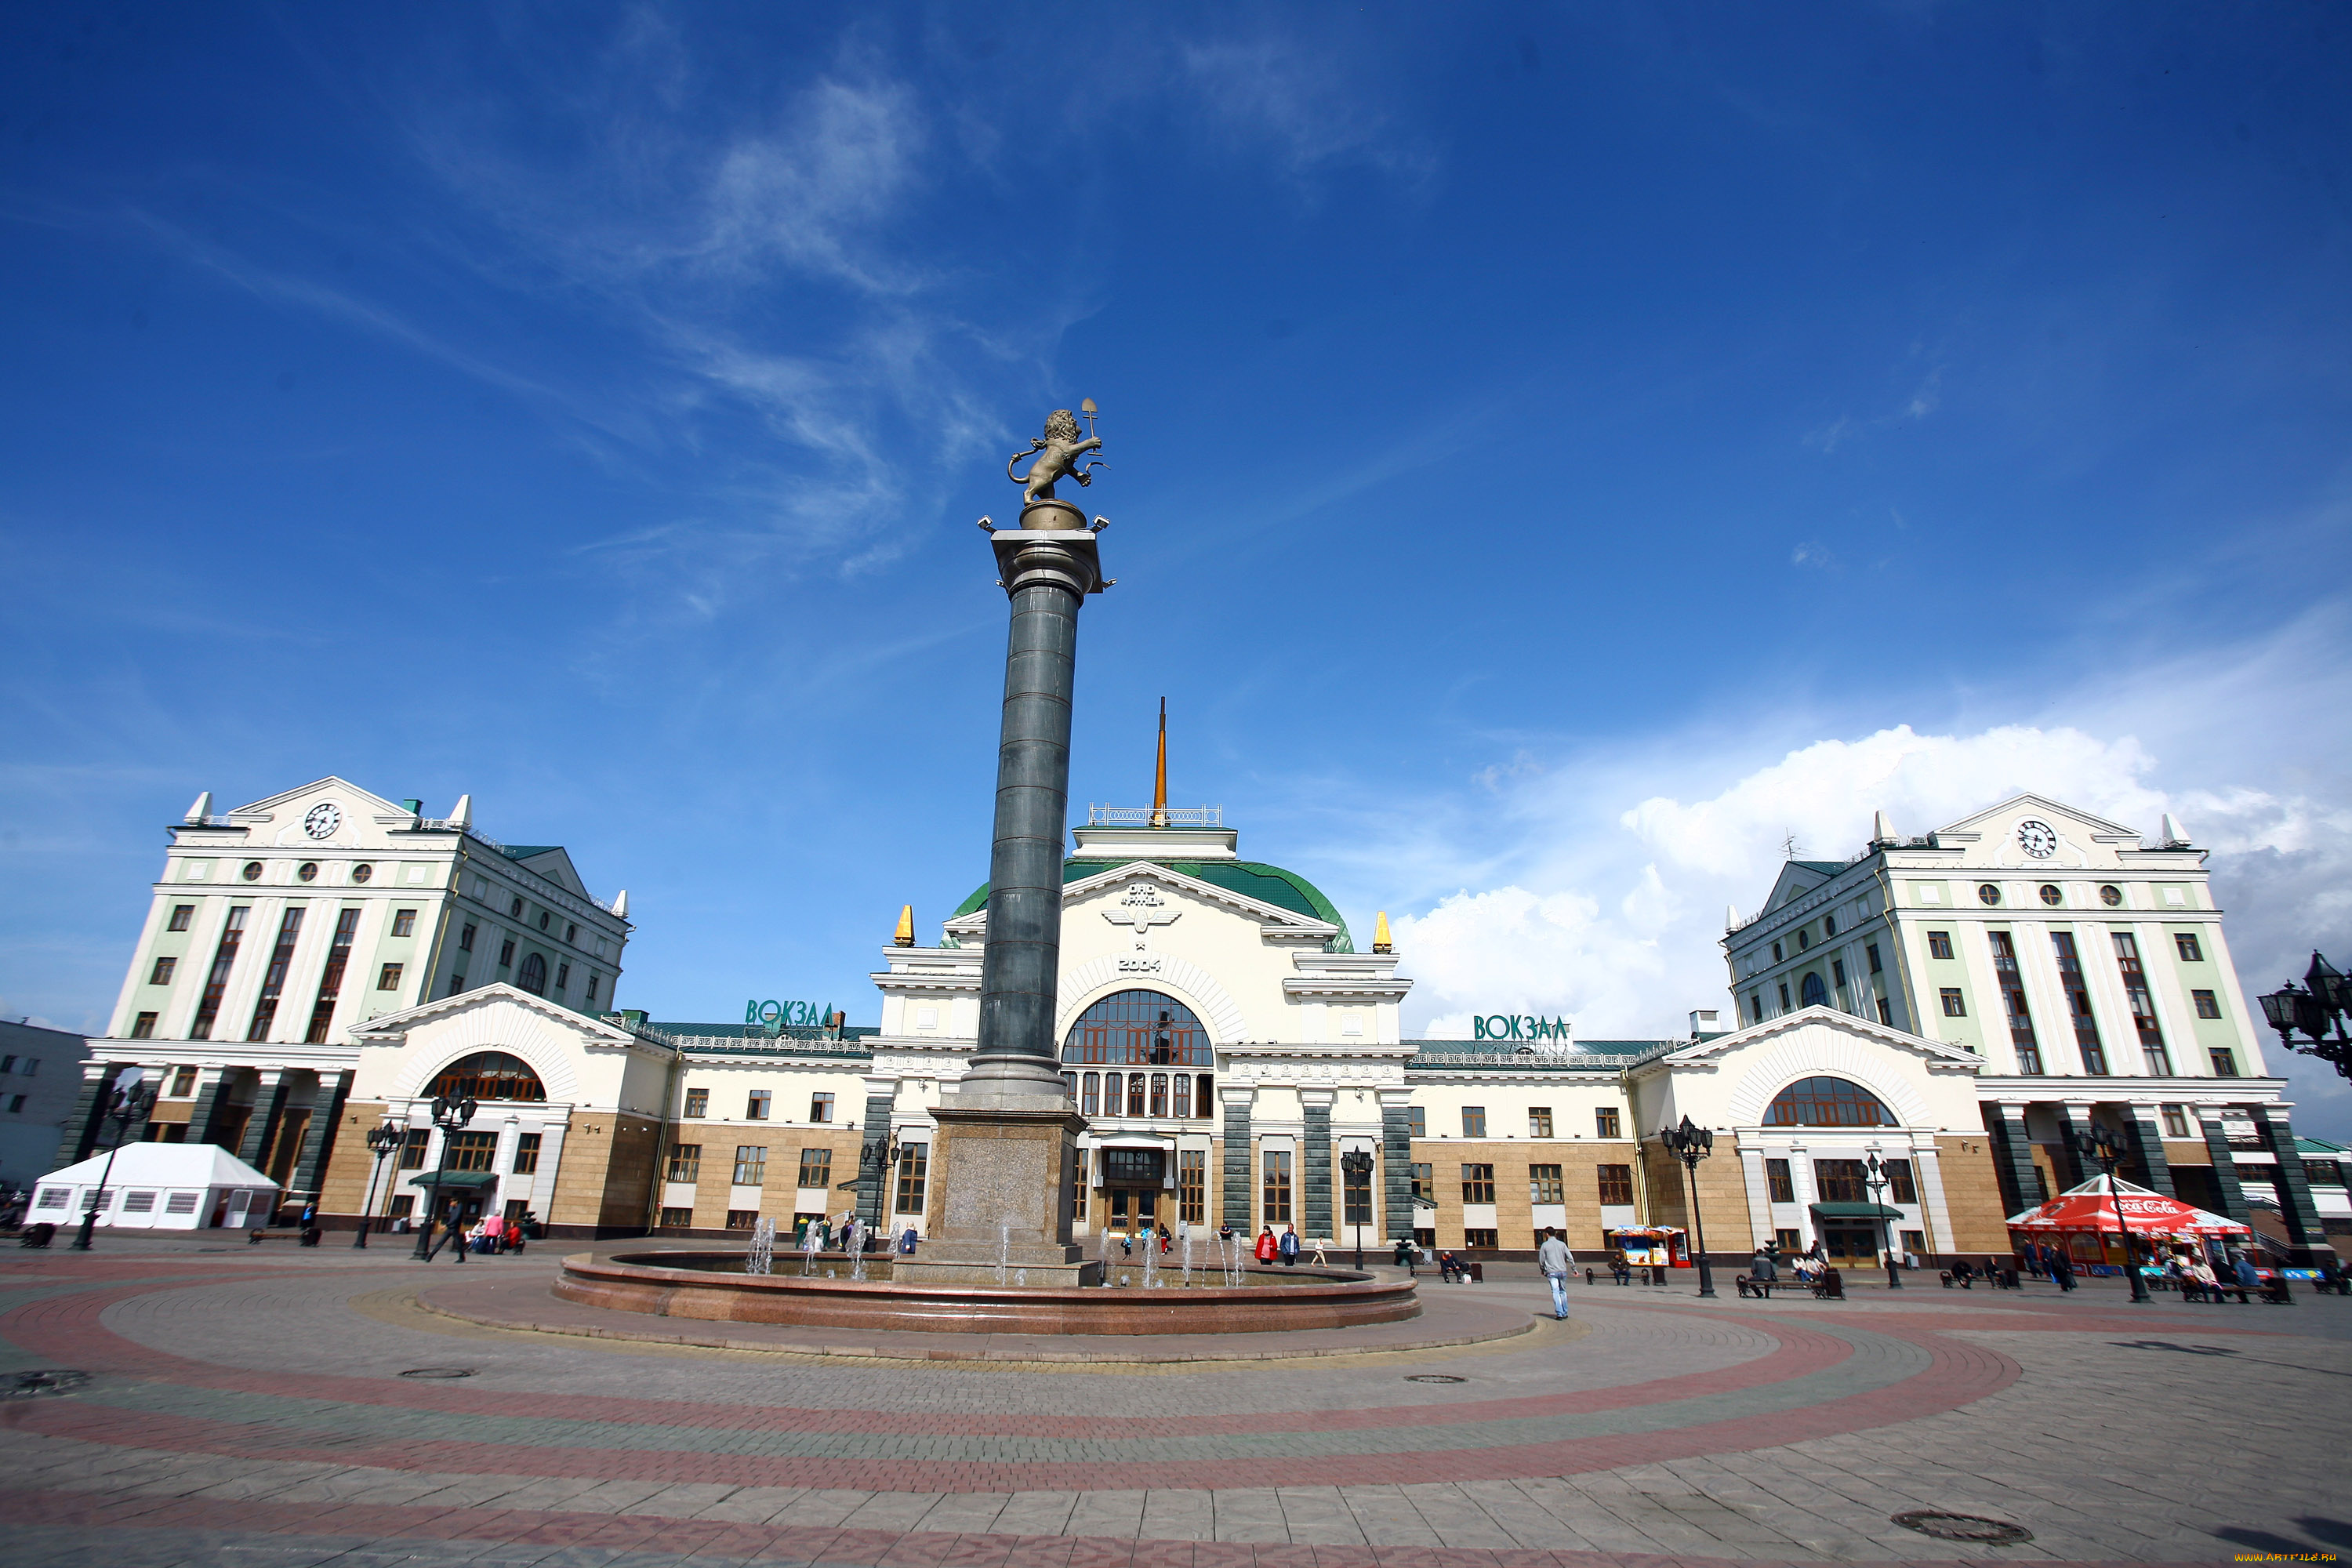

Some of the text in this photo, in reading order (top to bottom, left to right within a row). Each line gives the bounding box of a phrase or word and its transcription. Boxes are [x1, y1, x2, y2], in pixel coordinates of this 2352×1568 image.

[1119, 959, 1160, 972] 2004
[745, 1000, 834, 1025] ВОКЗАЛ
[1474, 1014, 1567, 1040] ВОКЗАЛ
